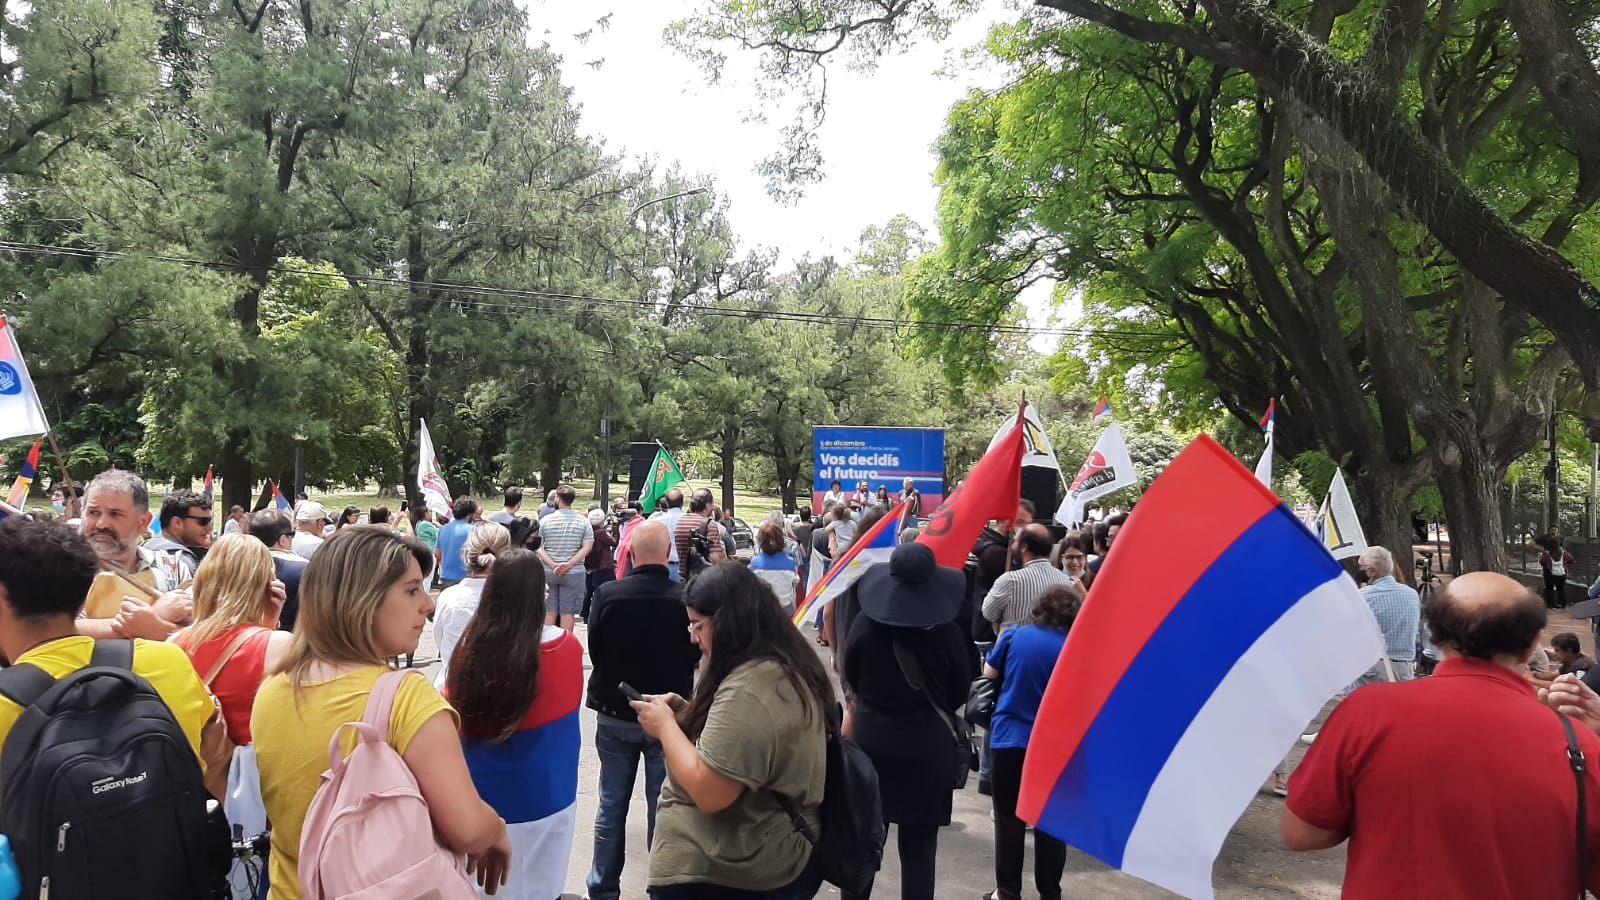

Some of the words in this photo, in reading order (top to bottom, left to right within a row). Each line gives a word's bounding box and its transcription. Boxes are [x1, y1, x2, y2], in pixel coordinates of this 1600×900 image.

[820, 453, 846, 466] Vos
[819, 466, 832, 479] el
[834, 466, 878, 479] futuro
[93, 780, 124, 793] Galaxy
